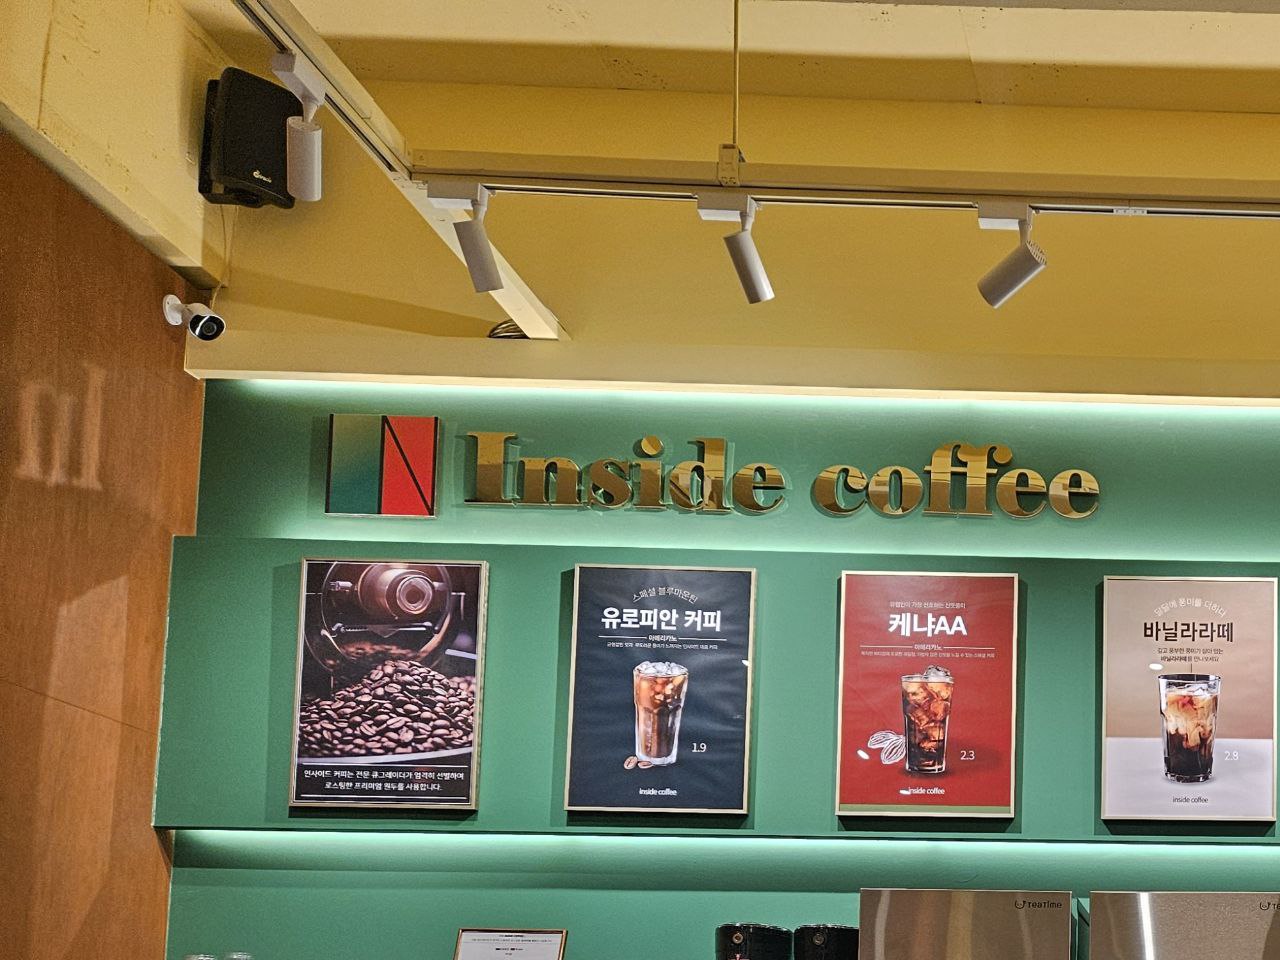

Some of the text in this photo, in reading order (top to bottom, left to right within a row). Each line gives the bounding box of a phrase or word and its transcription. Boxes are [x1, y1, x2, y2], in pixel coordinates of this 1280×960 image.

[464, 432, 1099, 519] Inside coffee
[632, 586, 698, 605] 스페셜 블루마운틴
[601, 606, 722, 632] 유로피안 커피
[888, 612, 967, 637] 케냐AA
[1143, 621, 1234, 643] 바닐라라떼
[648, 634, 678, 642] 아메리카노
[914, 643, 943, 651] 아메리카노
[691, 742, 707, 753] 1.9
[960, 750, 975, 761] 2.3
[1224, 750, 1239, 761] 2.8
[304, 769, 465, 781] 인사이드 커피는 전문 큐그레이더가 엄격히 선별하여
[324, 781, 443, 791] 로스팅한 프리미엄 원두를 사용합니다.
[639, 787, 678, 796] inside coffee
[908, 787, 945, 795] inside coffee
[1172, 796, 1208, 804] inside coffee
